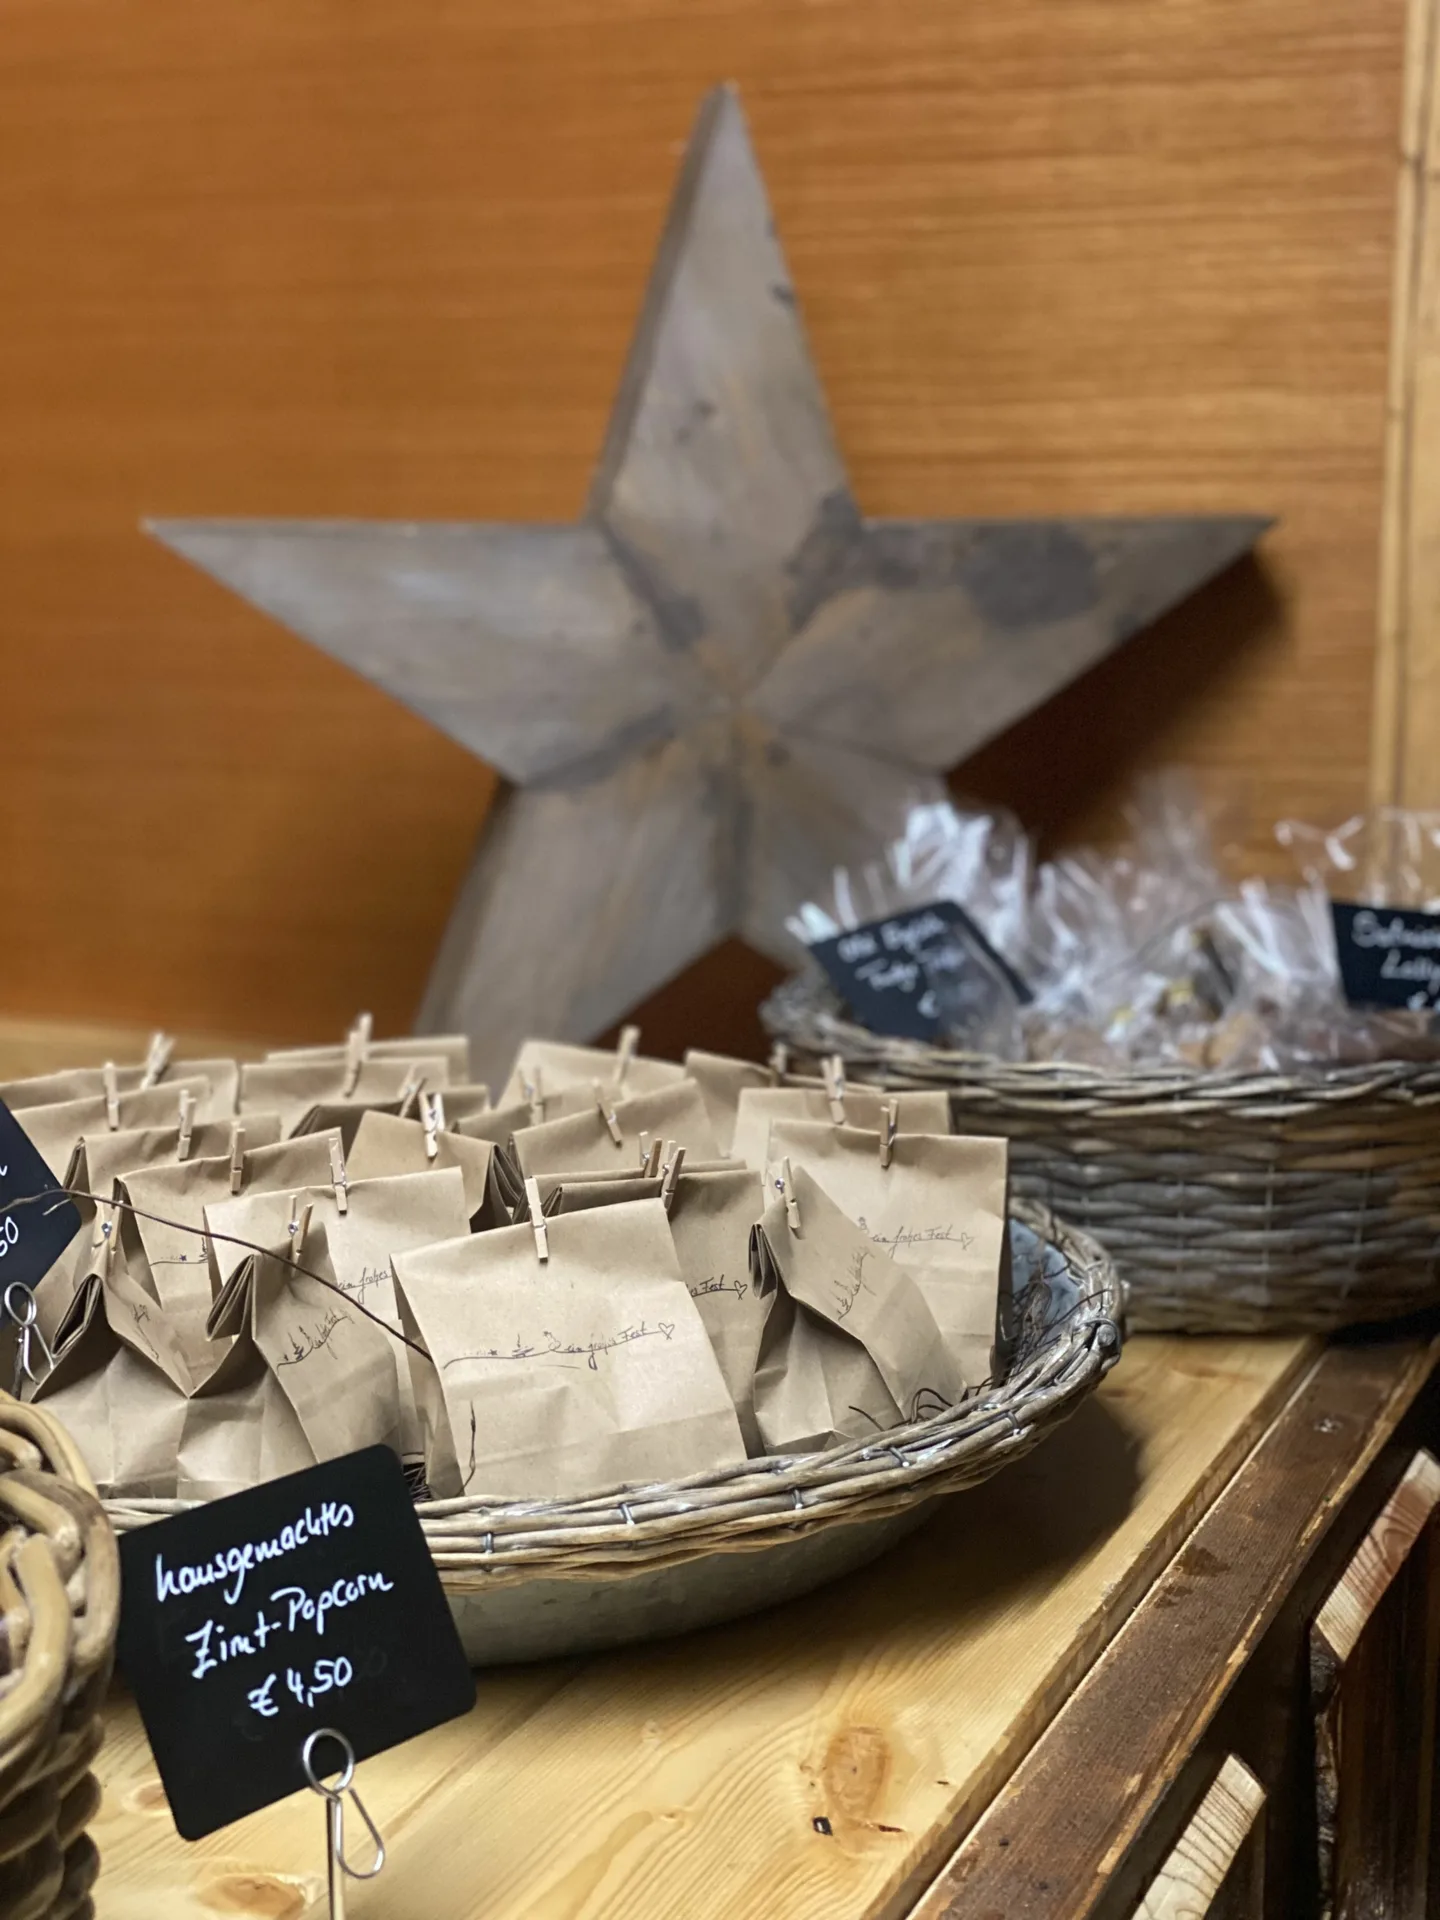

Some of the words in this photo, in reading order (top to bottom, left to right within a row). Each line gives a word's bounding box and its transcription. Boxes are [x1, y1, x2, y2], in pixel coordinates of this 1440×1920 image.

[925, 1224, 953, 1241] Fest
[618, 1321, 648, 1342] Fest
[156, 1502, 353, 1604] hausgemachtes
[185, 1573, 393, 1679] Zimt-Popcorn
[287, 1657, 353, 1708] 4,50
